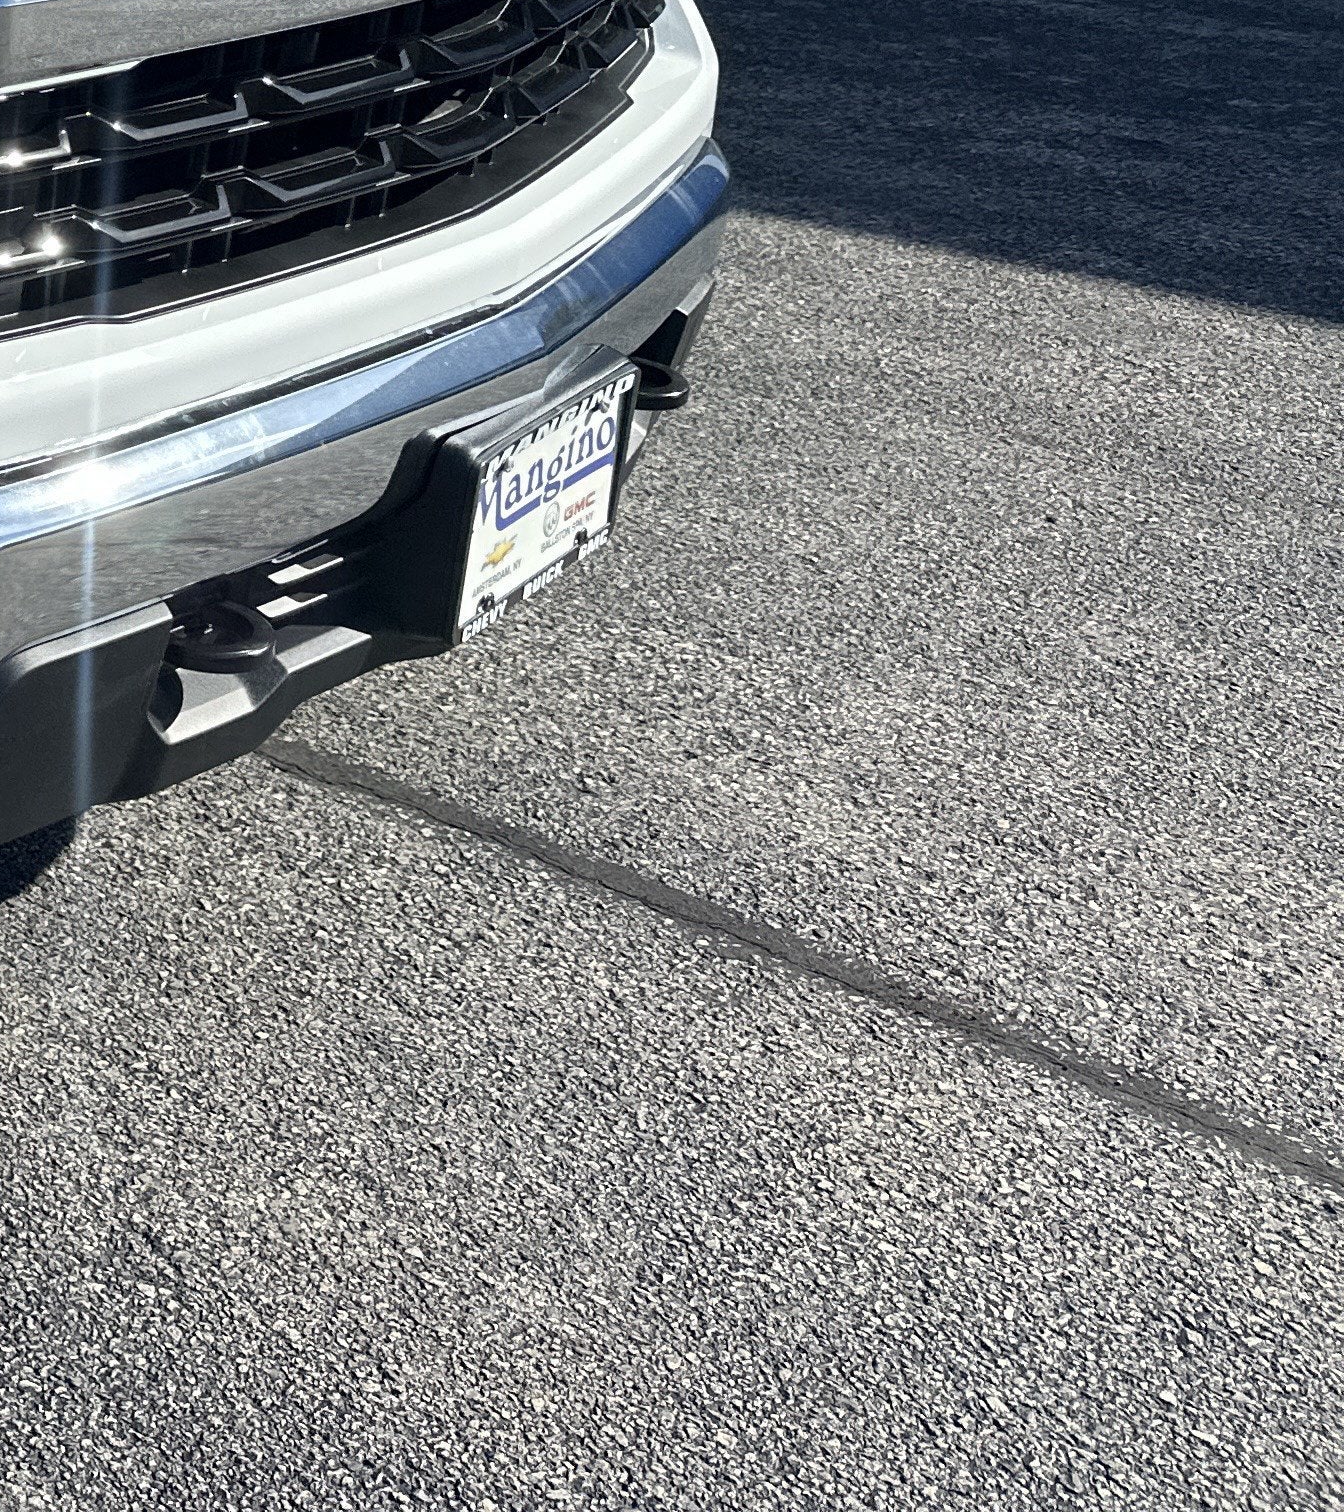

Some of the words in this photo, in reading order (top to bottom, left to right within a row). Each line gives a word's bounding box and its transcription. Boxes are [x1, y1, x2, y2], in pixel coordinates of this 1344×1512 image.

[478, 416, 618, 532] Mangino
[563, 491, 596, 522] GMC
[462, 599, 508, 643] CHEVY
